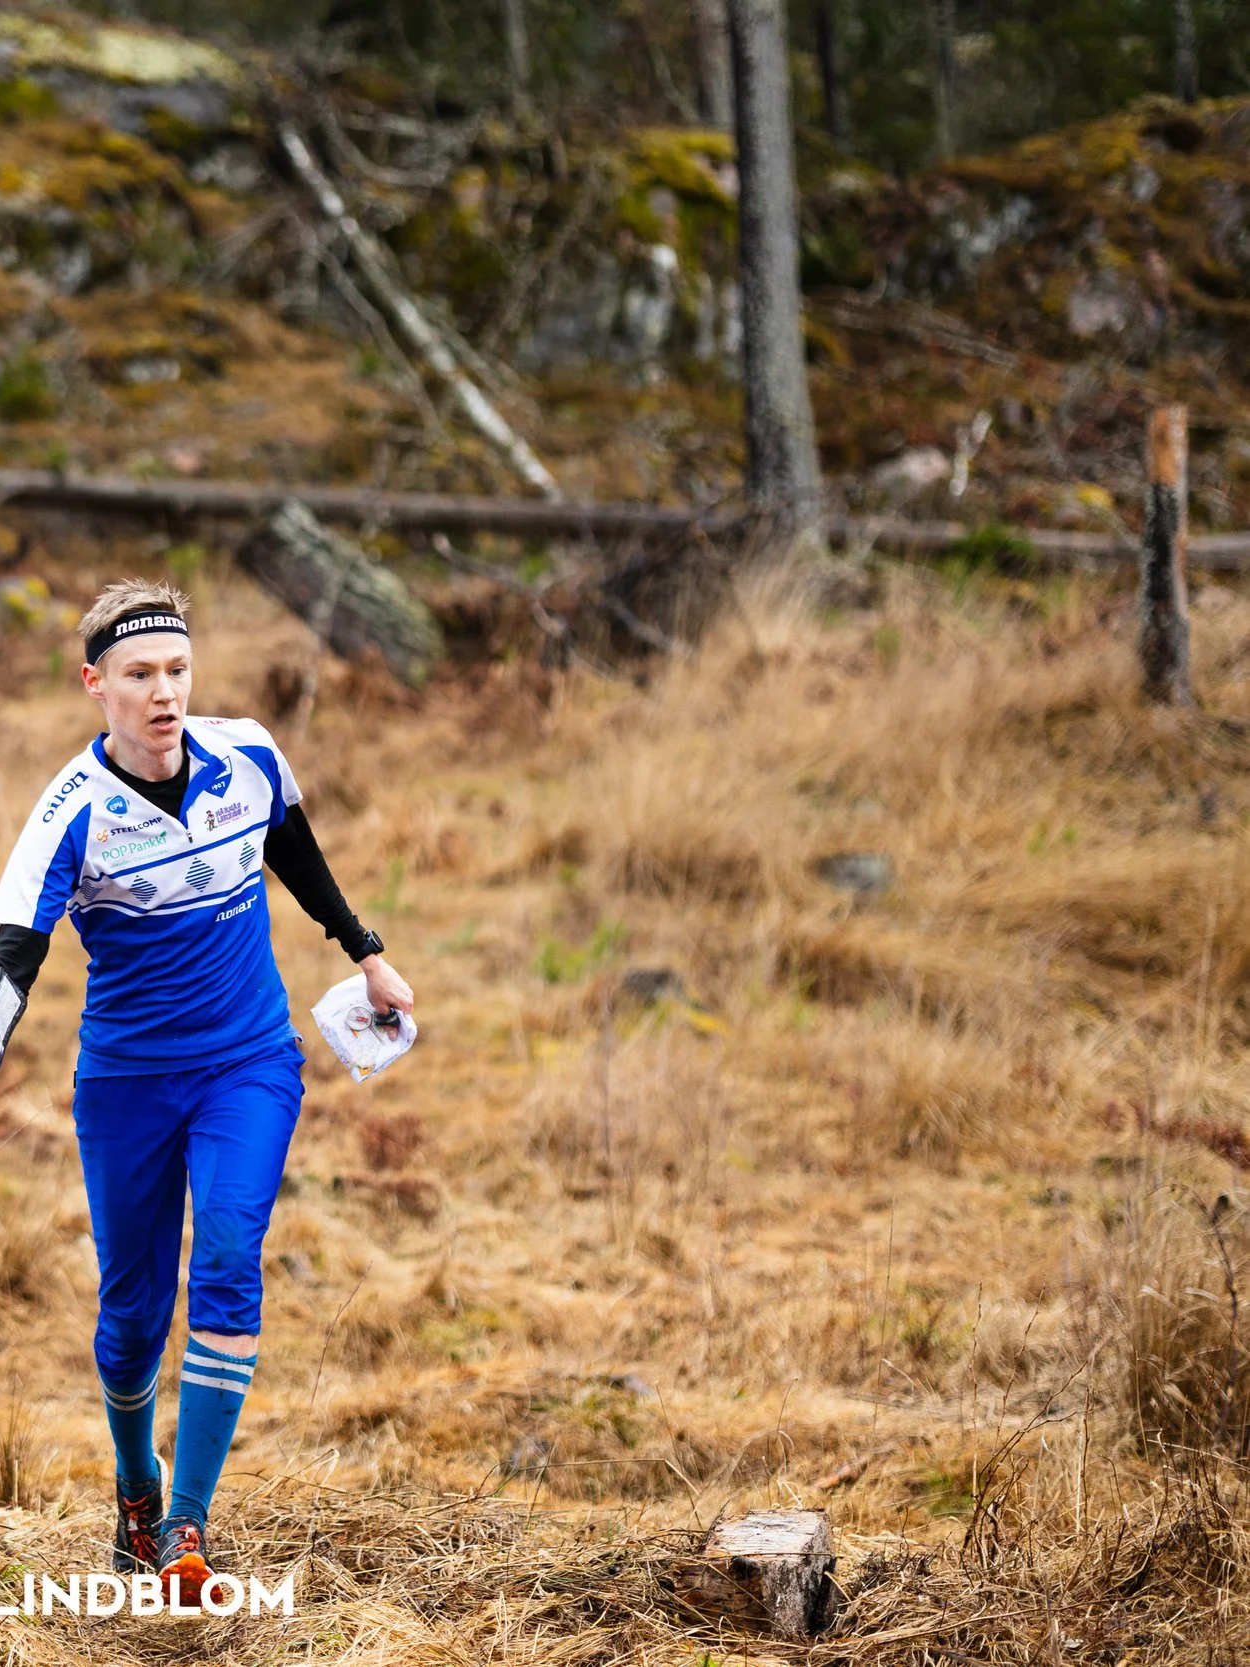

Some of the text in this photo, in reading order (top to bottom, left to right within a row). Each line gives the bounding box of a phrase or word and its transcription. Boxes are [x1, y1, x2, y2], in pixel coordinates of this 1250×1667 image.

[211, 781, 226, 791] 1907
[110, 816, 163, 836] STEELCOMP
[101, 845, 128, 861] POP
[128, 831, 168, 854] Pankki
